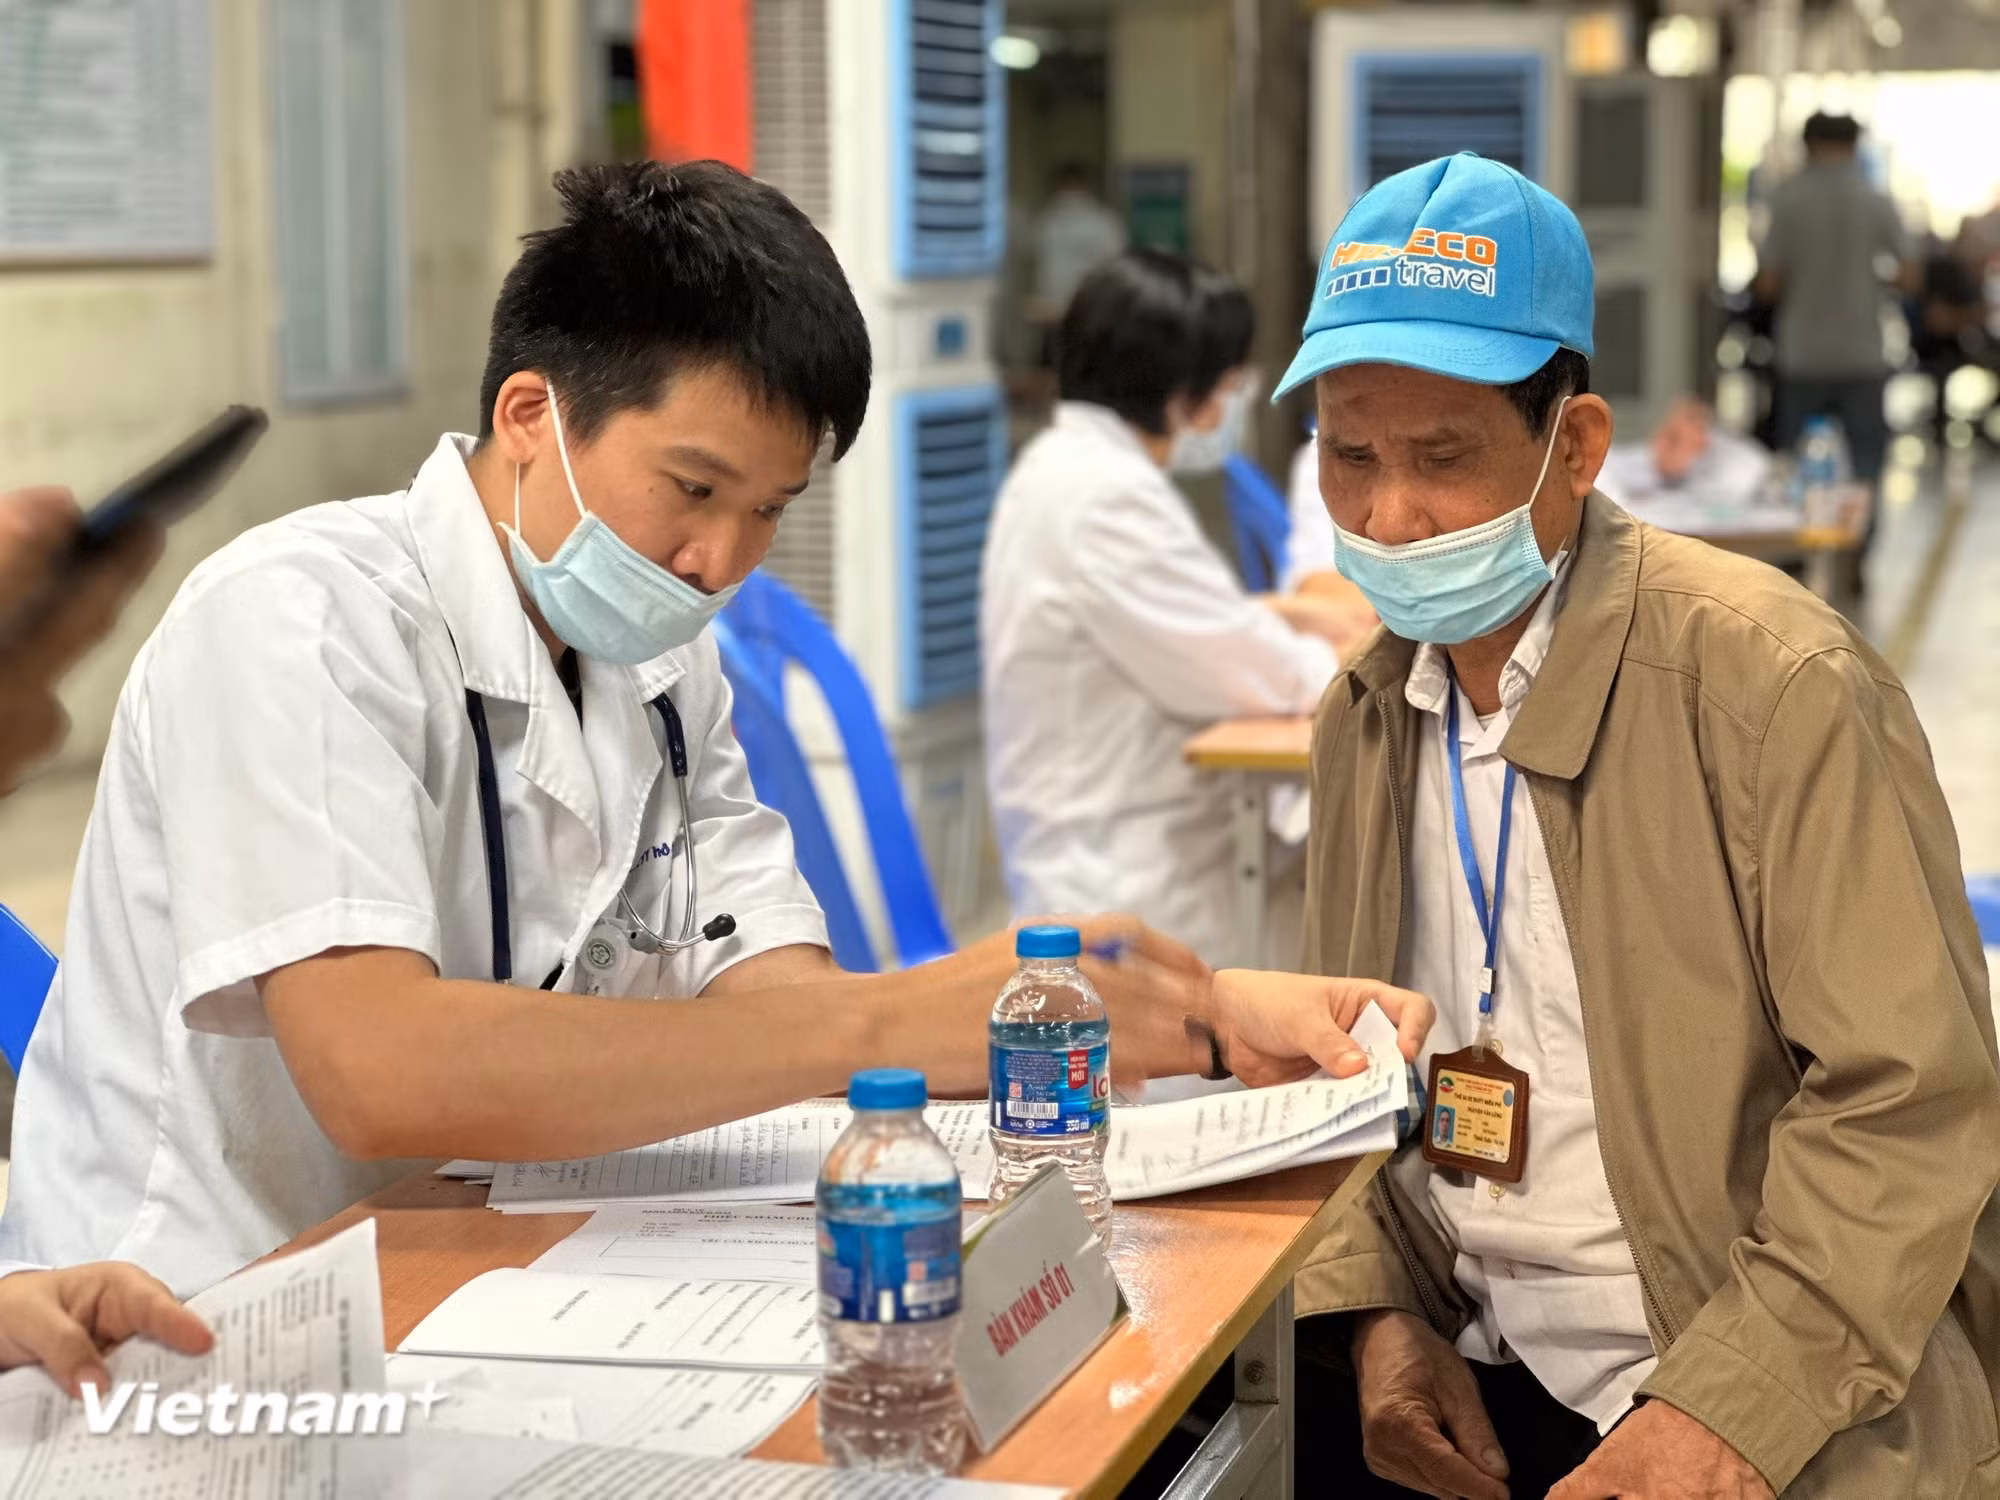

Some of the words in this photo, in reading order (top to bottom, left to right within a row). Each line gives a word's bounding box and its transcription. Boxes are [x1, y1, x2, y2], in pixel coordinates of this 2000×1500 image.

[1396, 256, 1496, 297] travel
[986, 1312, 1019, 1357] BÀN
[1008, 1286, 1049, 1338] KHÁM
[1039, 1259, 1062, 1310] SỐ
[1053, 1261, 1075, 1298] 01
